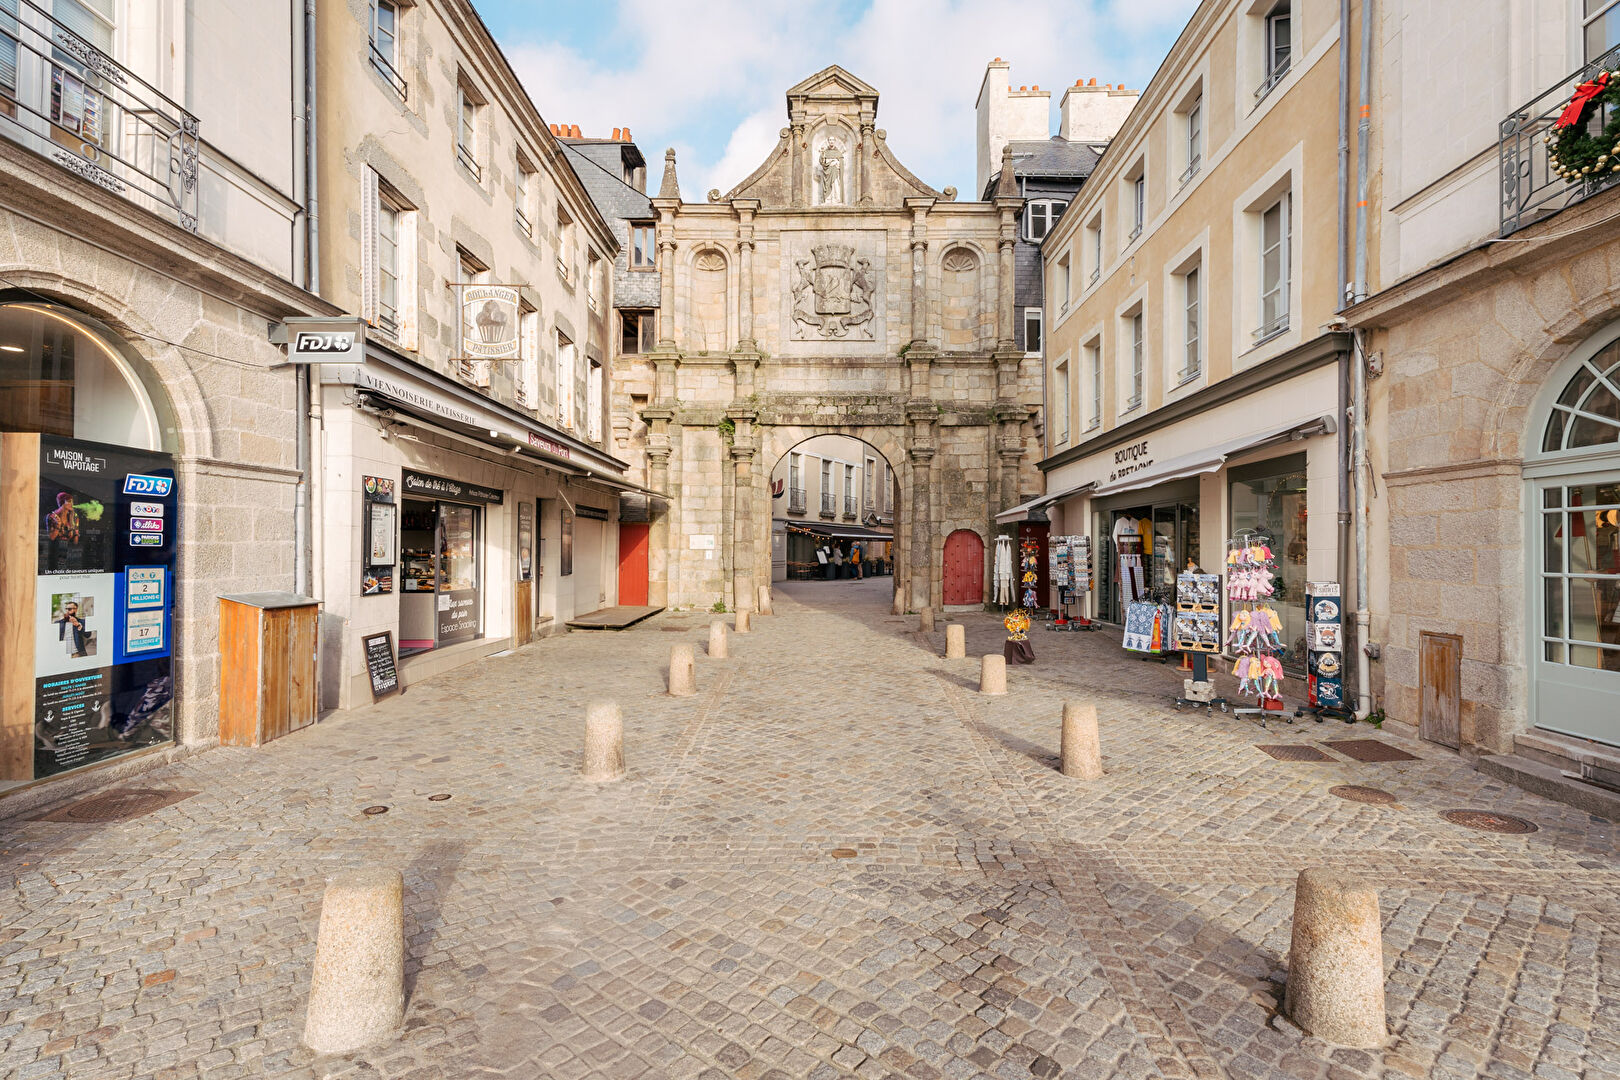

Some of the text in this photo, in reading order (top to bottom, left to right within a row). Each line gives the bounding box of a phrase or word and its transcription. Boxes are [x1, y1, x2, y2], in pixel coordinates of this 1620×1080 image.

[467, 288, 515, 302] BOULANGER
[299, 335, 333, 351] FDJ
[366, 375, 477, 425] VIENNOISERIE PATISSERIE
[53, 449, 83, 461] MAISON
[1114, 441, 1148, 465] BOUTIQUE
[63, 459, 100, 472] VAPOTAGE
[127, 478, 155, 492] FDJ
[406, 475, 425, 489] Salon
[424, 479, 433, 489] de
[142, 584, 148, 592] 2
[139, 628, 150, 637] 17
[440, 623, 459, 635] Espace
[43, 680, 69, 688] HORAIRES
[62, 703, 85, 712] SERVICES
